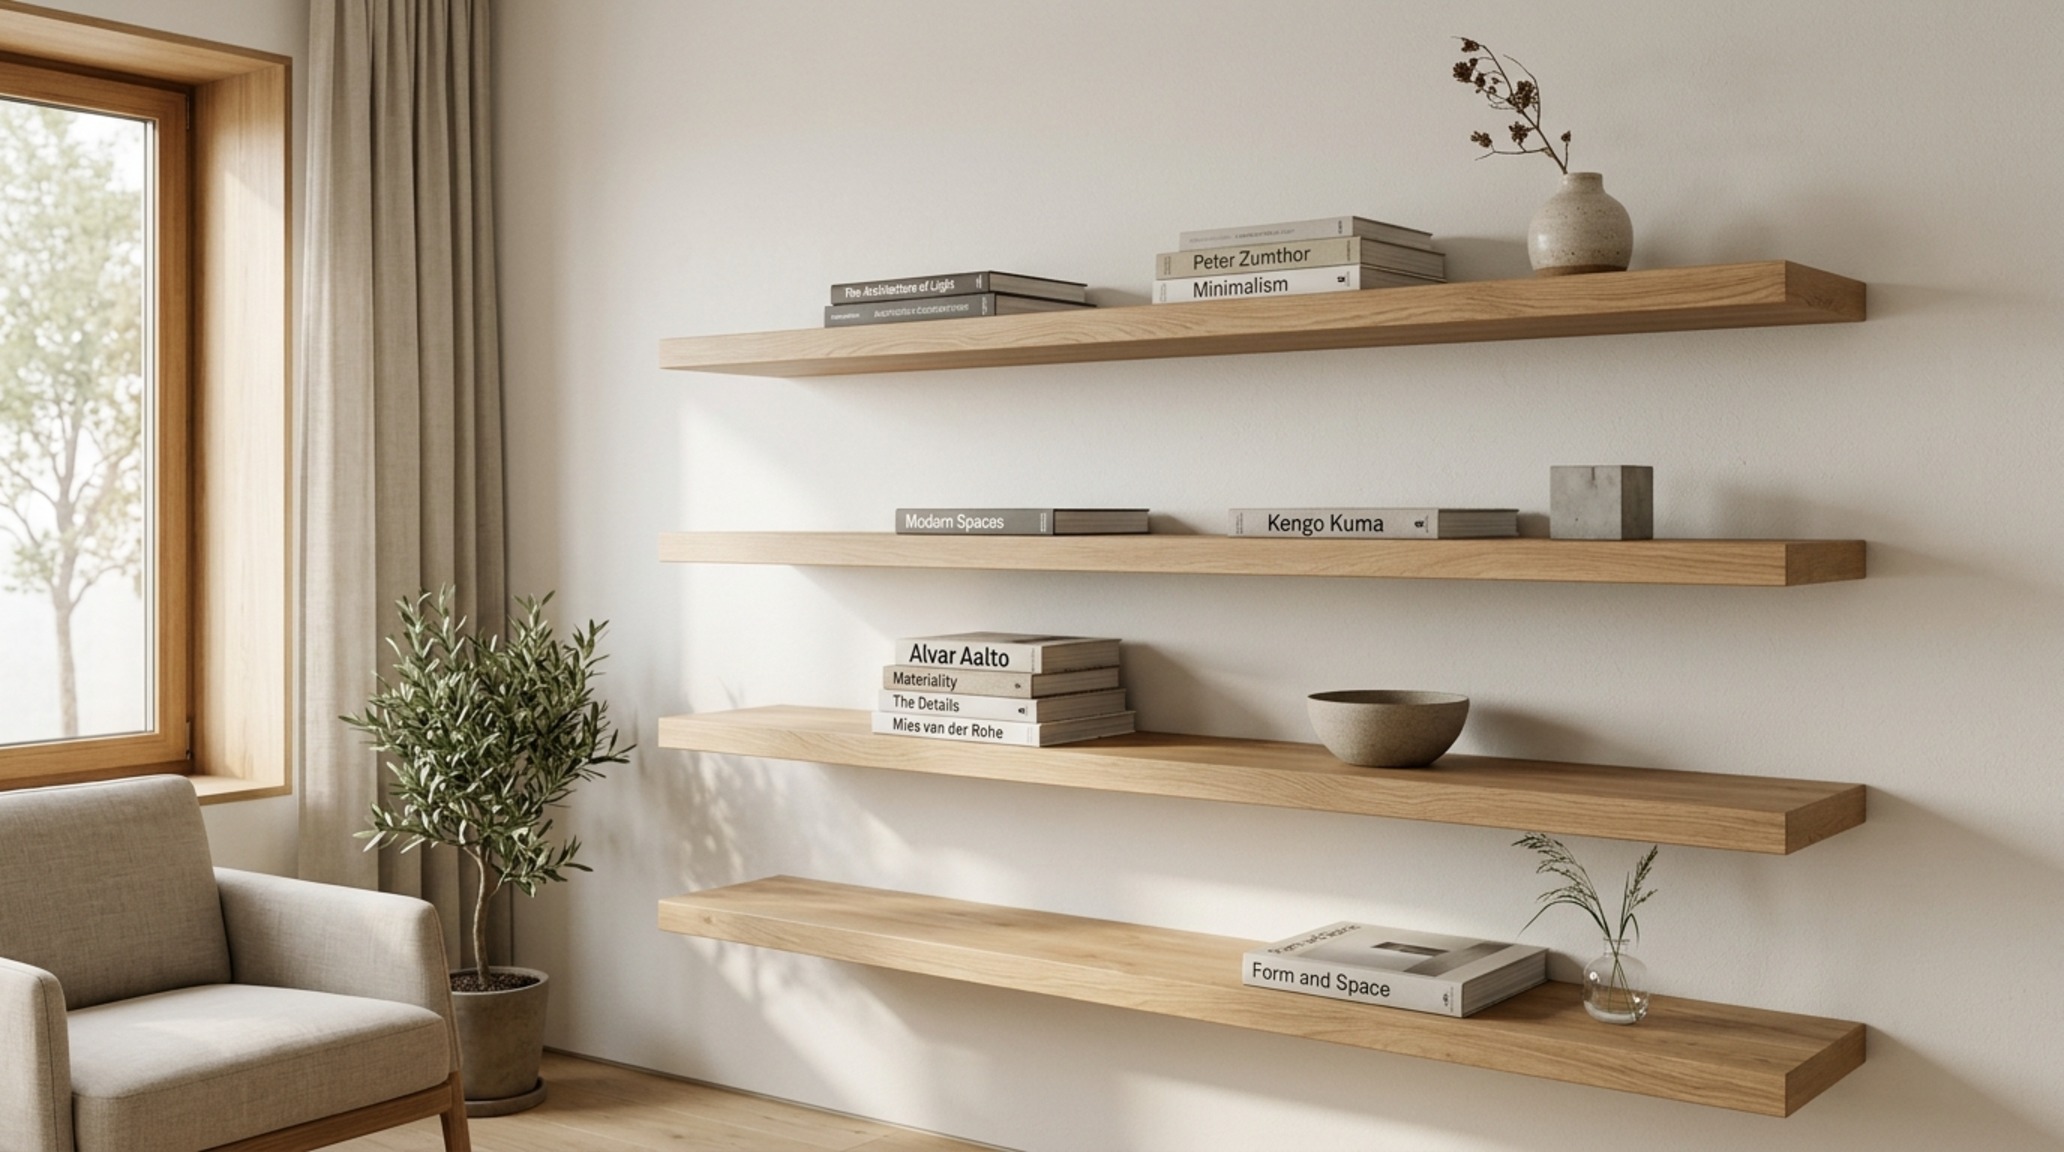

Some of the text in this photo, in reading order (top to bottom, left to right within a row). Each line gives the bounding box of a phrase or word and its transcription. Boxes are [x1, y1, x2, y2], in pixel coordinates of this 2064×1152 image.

[1193, 253, 1236, 271] Peter
[1239, 246, 1313, 266] Zumthor
[1193, 276, 1289, 298] Minimalism
[956, 513, 1005, 533] Spaces
[1267, 513, 1325, 537] Kengo
[1330, 513, 1385, 533] Kuma
[909, 644, 957, 664] Alvar
[960, 646, 1010, 668] Aalto
[893, 672, 958, 691] Materiality
[893, 695, 960, 712] The Details
[893, 718, 1004, 740] Mies van der Rohe
[1252, 961, 1391, 996] Form and Space
